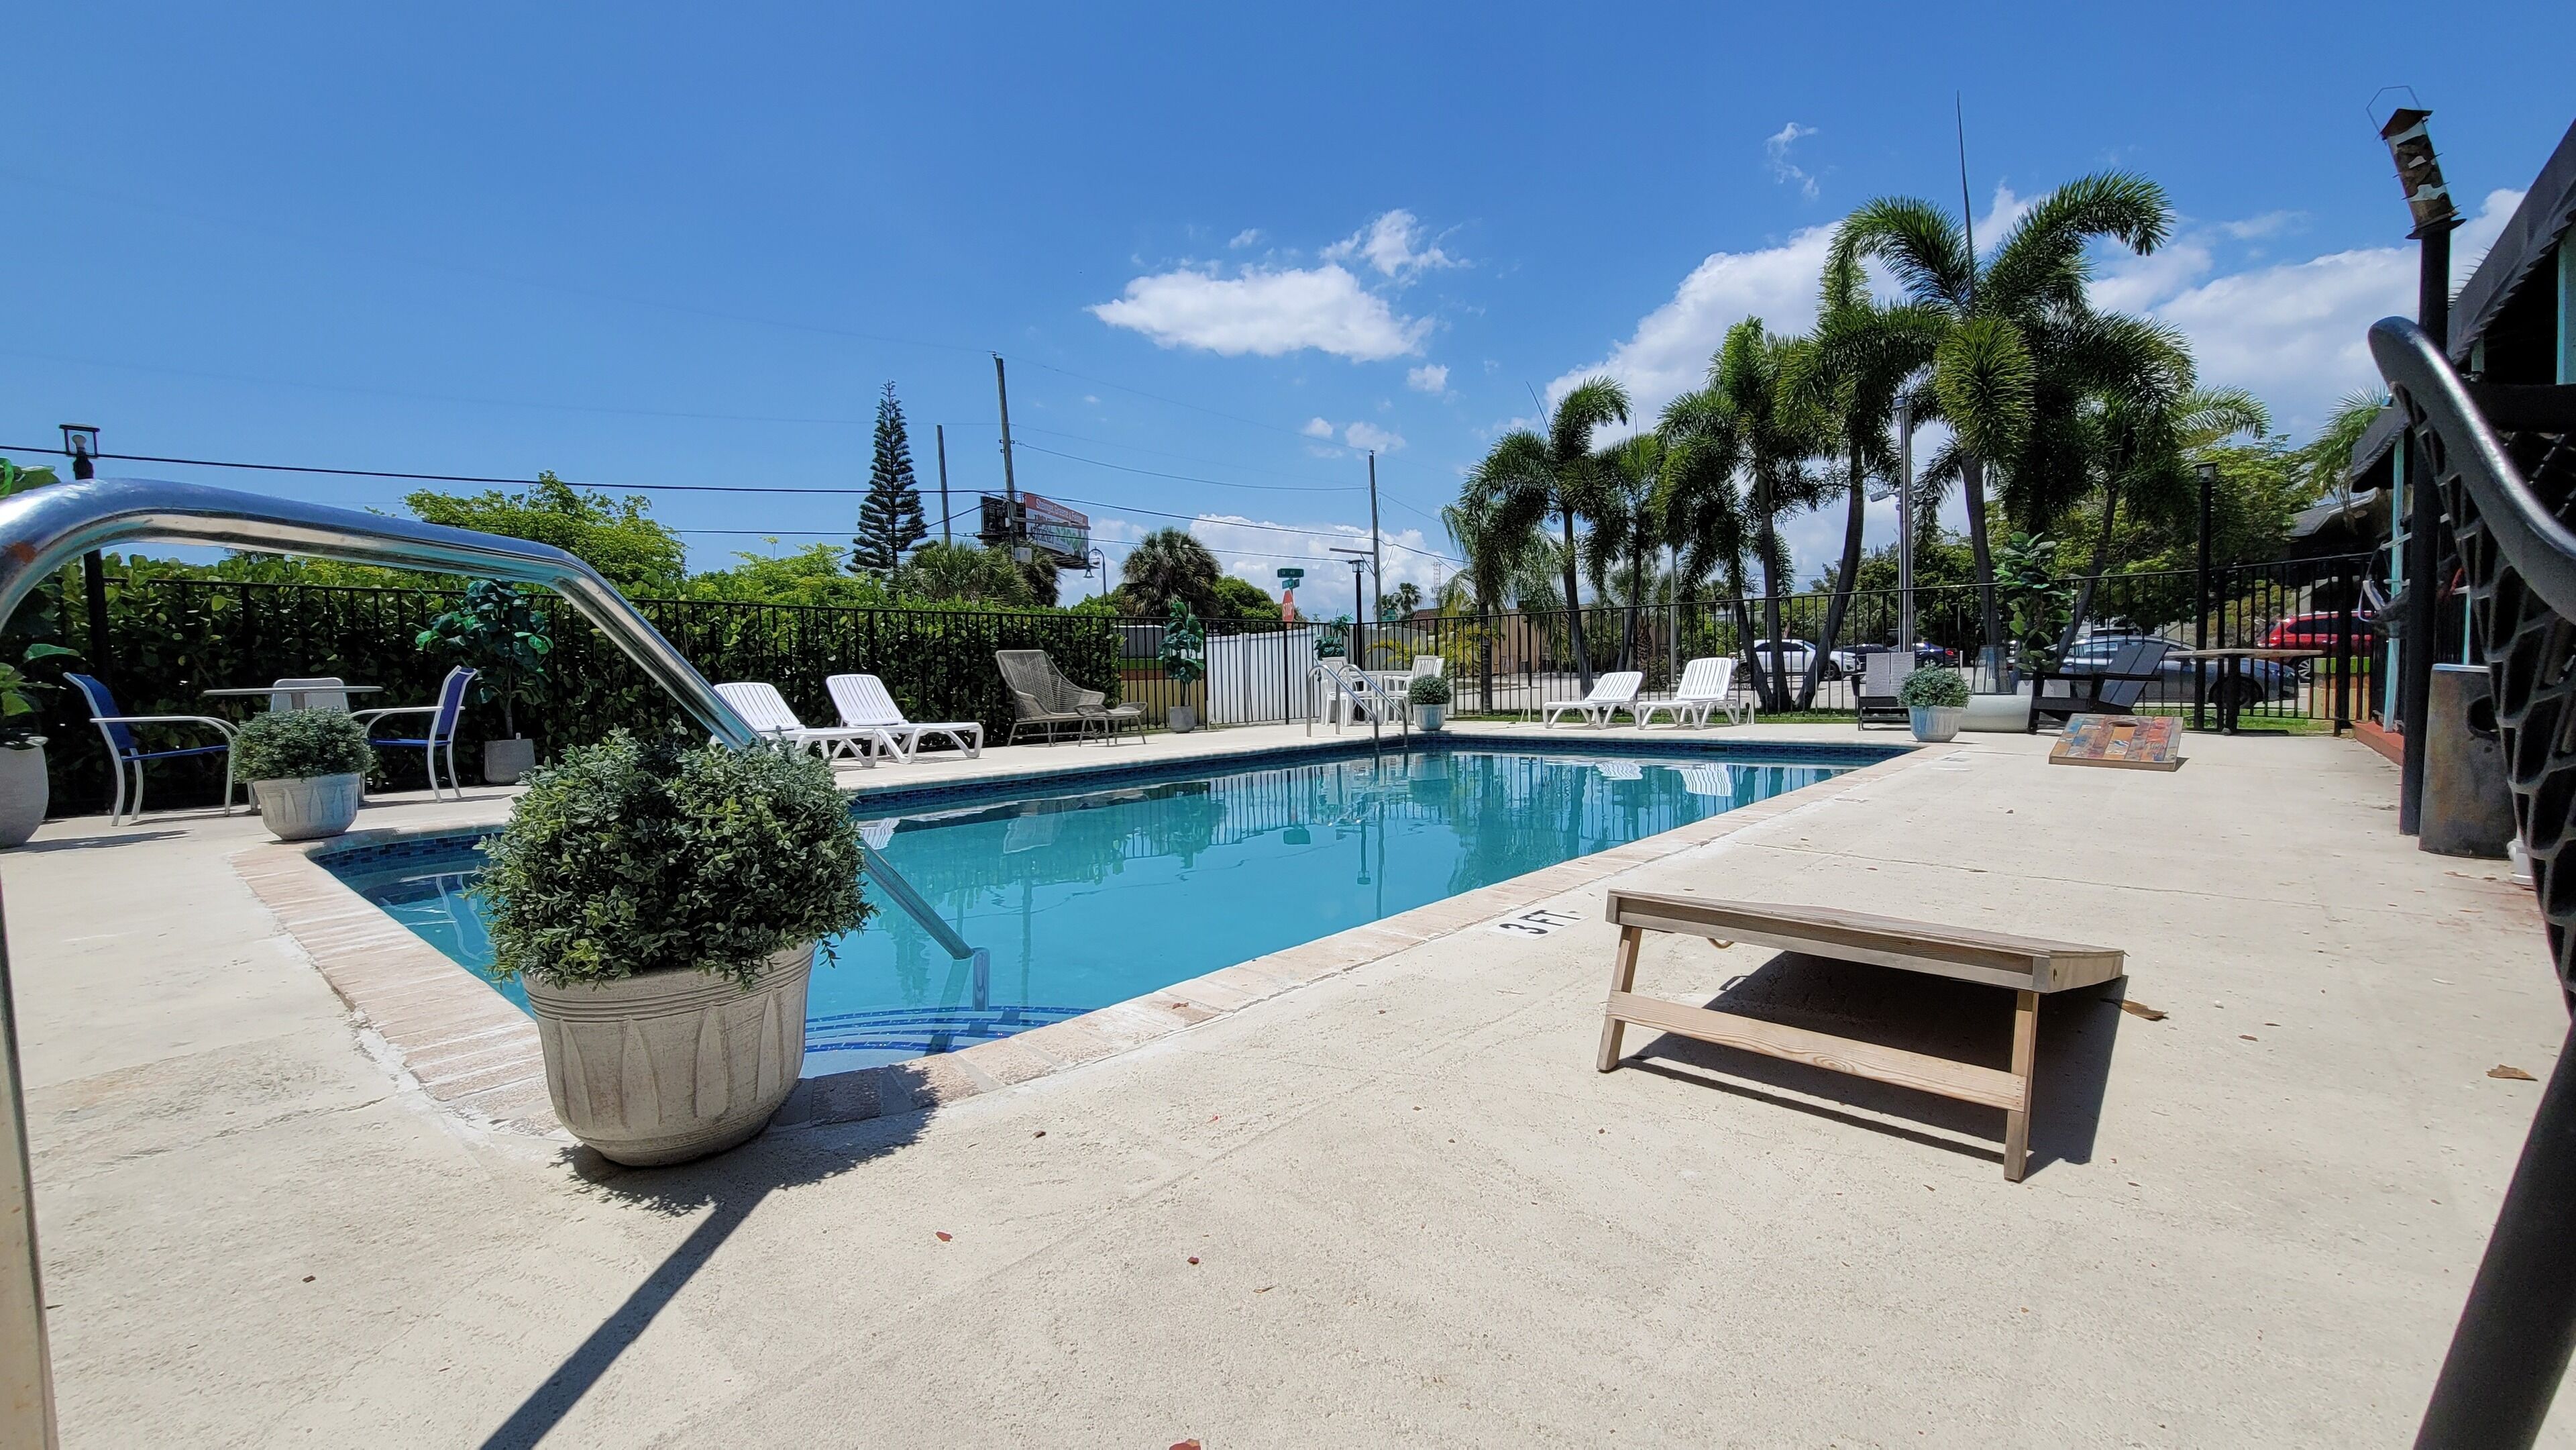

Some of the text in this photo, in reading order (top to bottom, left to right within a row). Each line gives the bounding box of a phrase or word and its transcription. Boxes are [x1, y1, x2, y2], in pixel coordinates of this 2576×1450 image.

[1283, 601, 1293, 617] STOP
[1499, 909, 1581, 934] 3 FT
